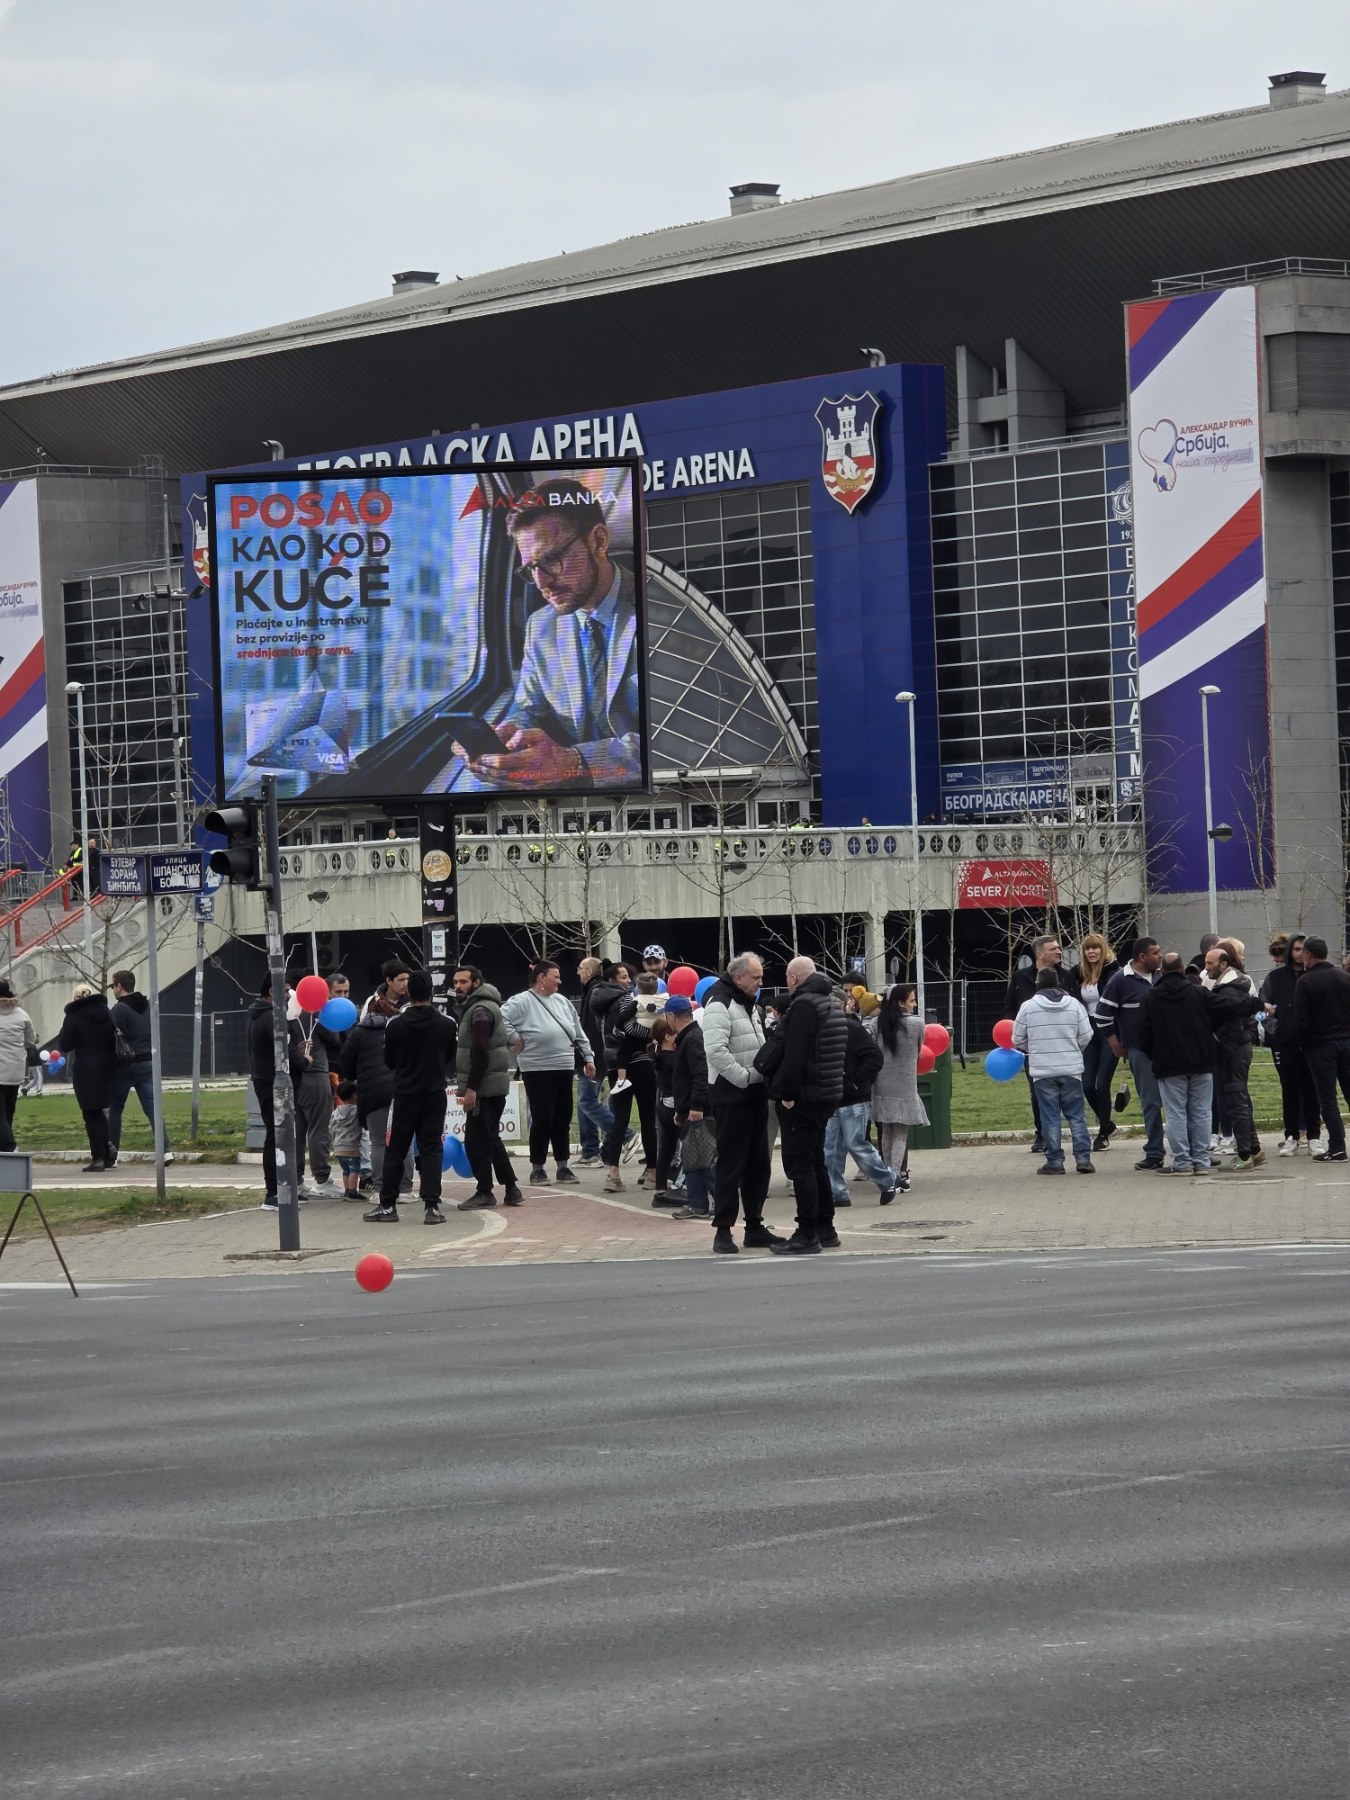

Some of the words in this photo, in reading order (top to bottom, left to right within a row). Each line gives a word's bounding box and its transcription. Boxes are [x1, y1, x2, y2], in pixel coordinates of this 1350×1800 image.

[1180, 421, 1229, 435] АЛЕКСАНДАР
[1229, 417, 1253, 428] ВУЧИЋ
[529, 412, 645, 461] АРЕНА
[1174, 432, 1229, 457] Србија,
[671, 447, 755, 489] ARENA
[230, 489, 393, 530] POSAO
[232, 534, 307, 562] KAO
[314, 531, 391, 560] KOD
[234, 553, 391, 613] KUĆE
[236, 617, 283, 630] Plaćajte
[285, 619, 293, 628] u
[236, 634, 256, 644] bez
[259, 632, 308, 646] provizije
[310, 632, 326, 645] po
[315, 752, 345, 765] VISA
[945, 790, 1027, 811] БЕОГРАДСКА
[1028, 788, 1072, 805] АРЕНА
[110, 857, 136, 868] БУЛЕВАР
[165, 856, 187, 865] УЛИЦА
[110, 868, 139, 880] ЗОРАНА
[153, 863, 201, 877] ШПАНСКИХ
[107, 880, 142, 892] ЂИНЂИЋА
[966, 884, 1001, 898] SEVER
